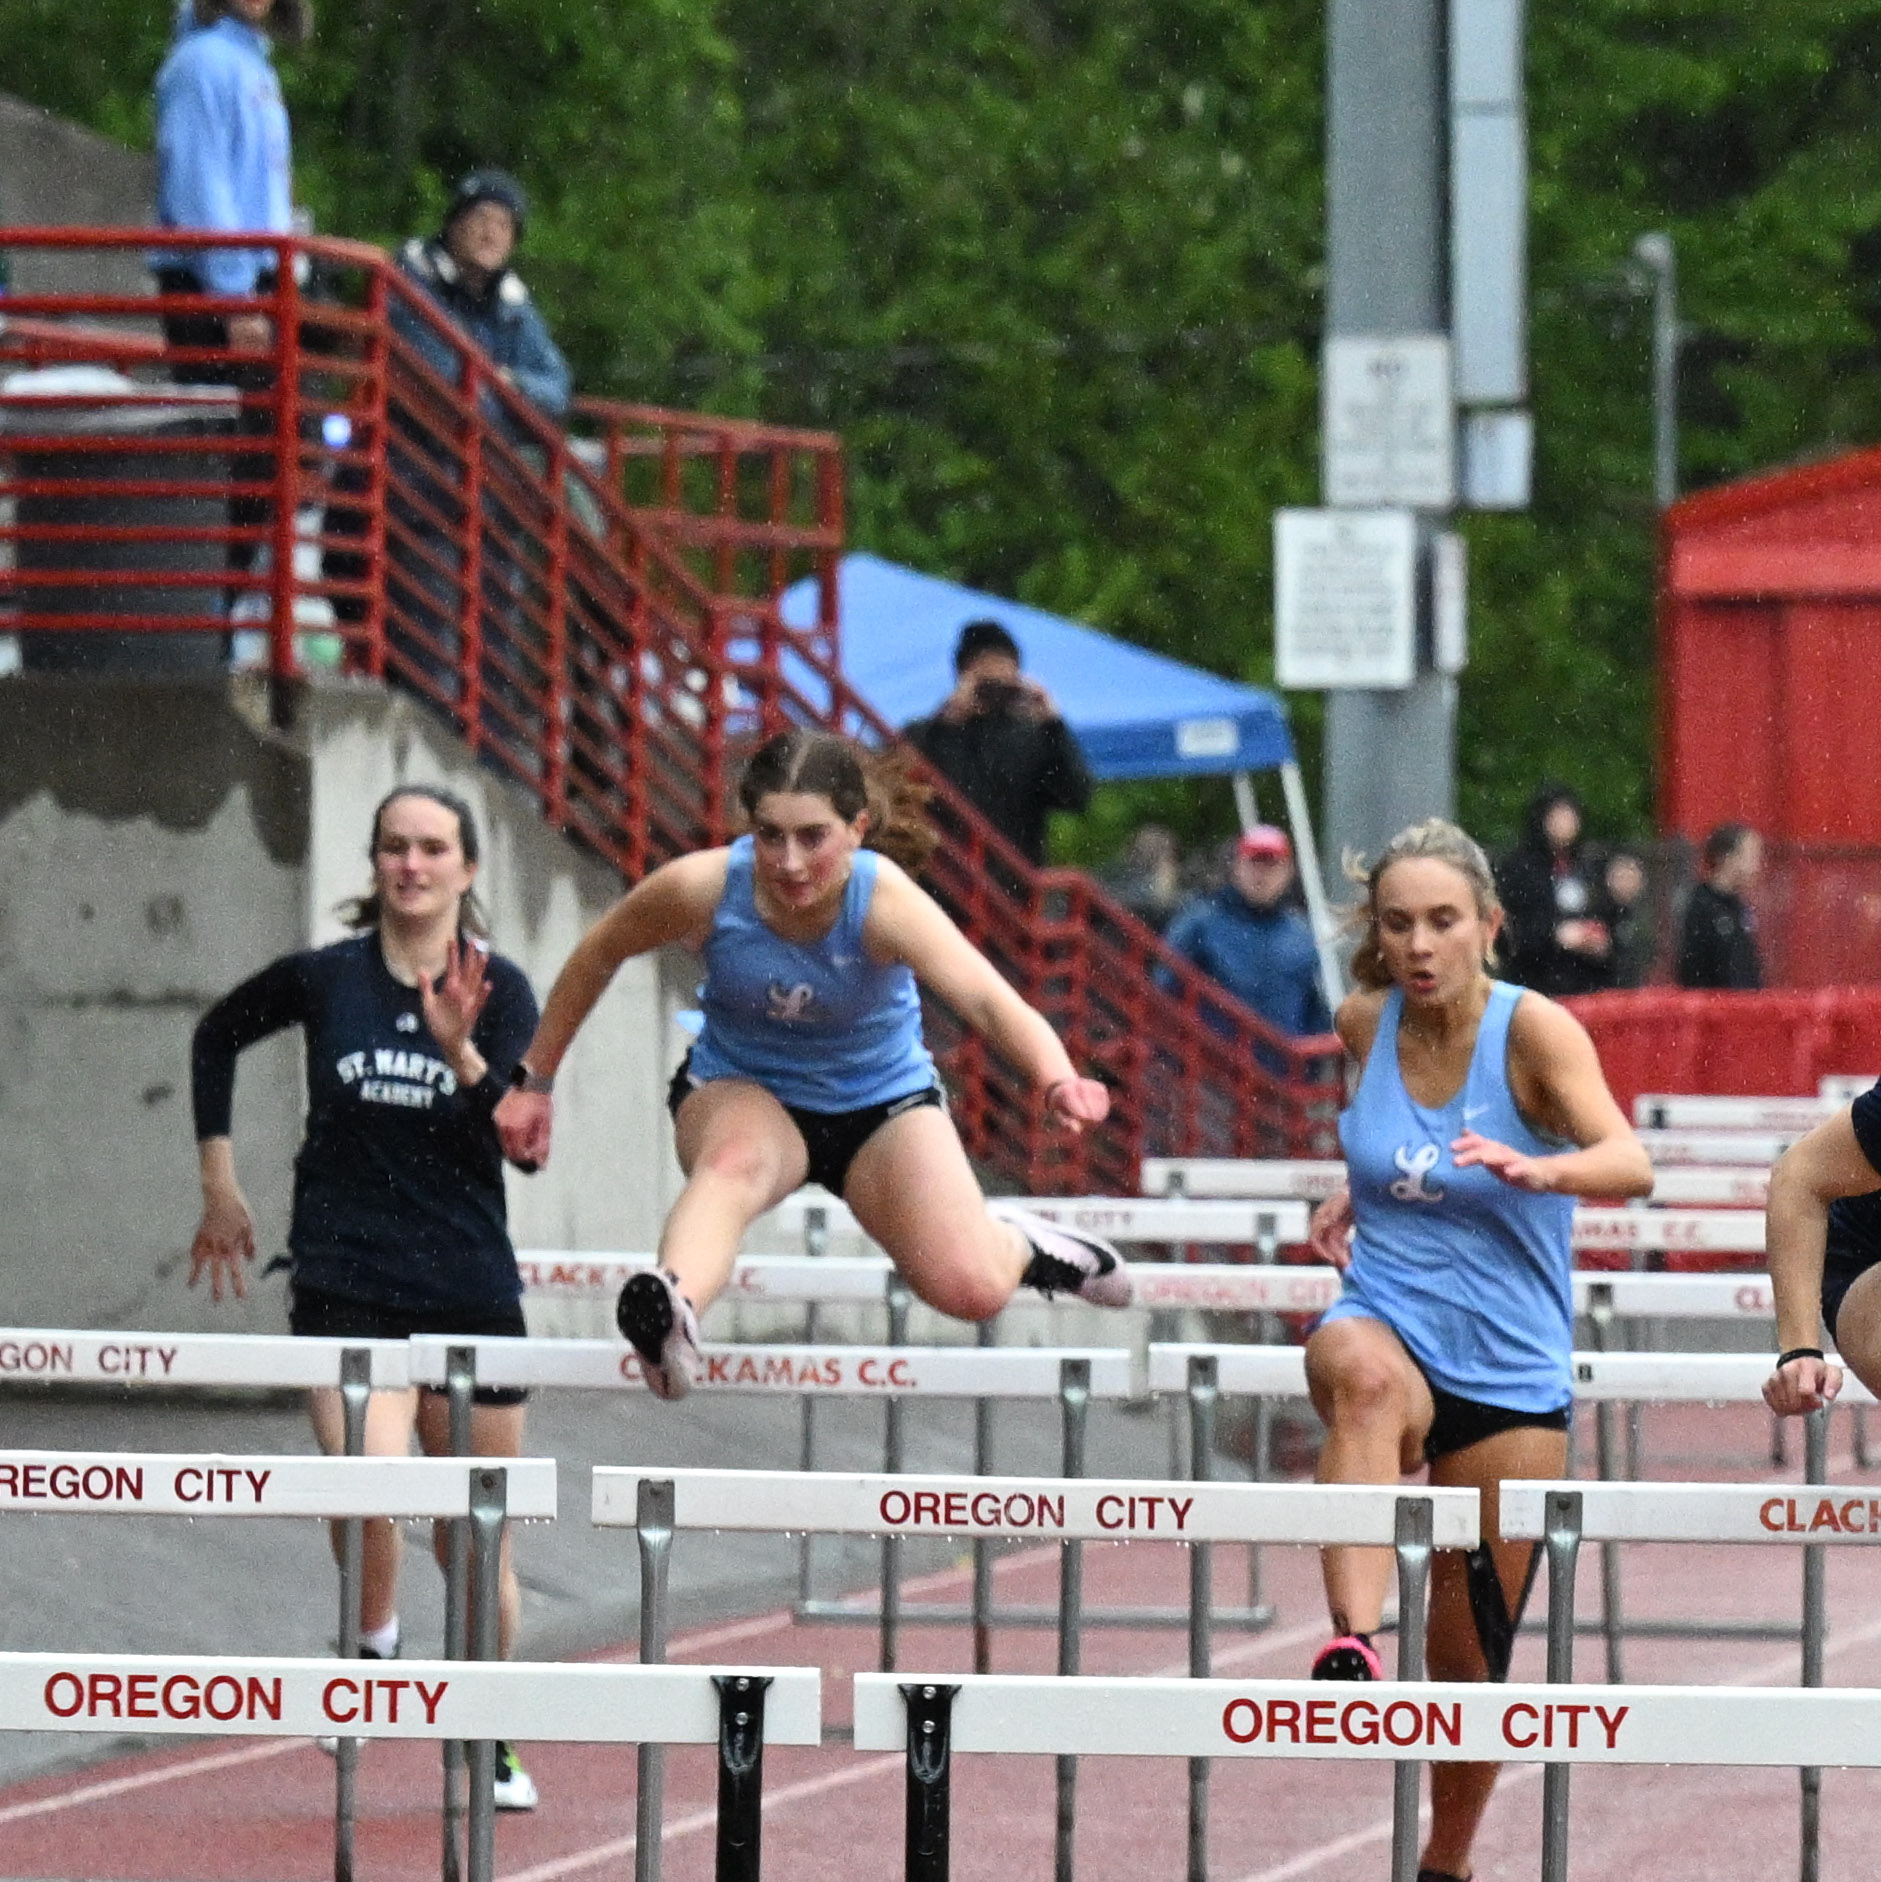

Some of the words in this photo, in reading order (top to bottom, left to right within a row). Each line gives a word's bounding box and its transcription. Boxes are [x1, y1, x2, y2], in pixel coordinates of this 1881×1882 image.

[359, 1079, 436, 1110] ACADEMY
[0, 1343, 73, 1372] GON
[98, 1346, 178, 1375] CITY
[620, 1353, 842, 1386] CKAMAS
[857, 1358, 917, 1387] C.C.
[0, 1464, 144, 1501] REGON
[174, 1467, 271, 1503] CITY
[879, 1490, 1065, 1529] OREGON
[1095, 1495, 1195, 1531] CITY
[44, 1671, 282, 1722] OREGON
[322, 1677, 449, 1725] CITY
[1222, 1698, 1462, 1747] OREGON
[1501, 1702, 1629, 1749] CITY
